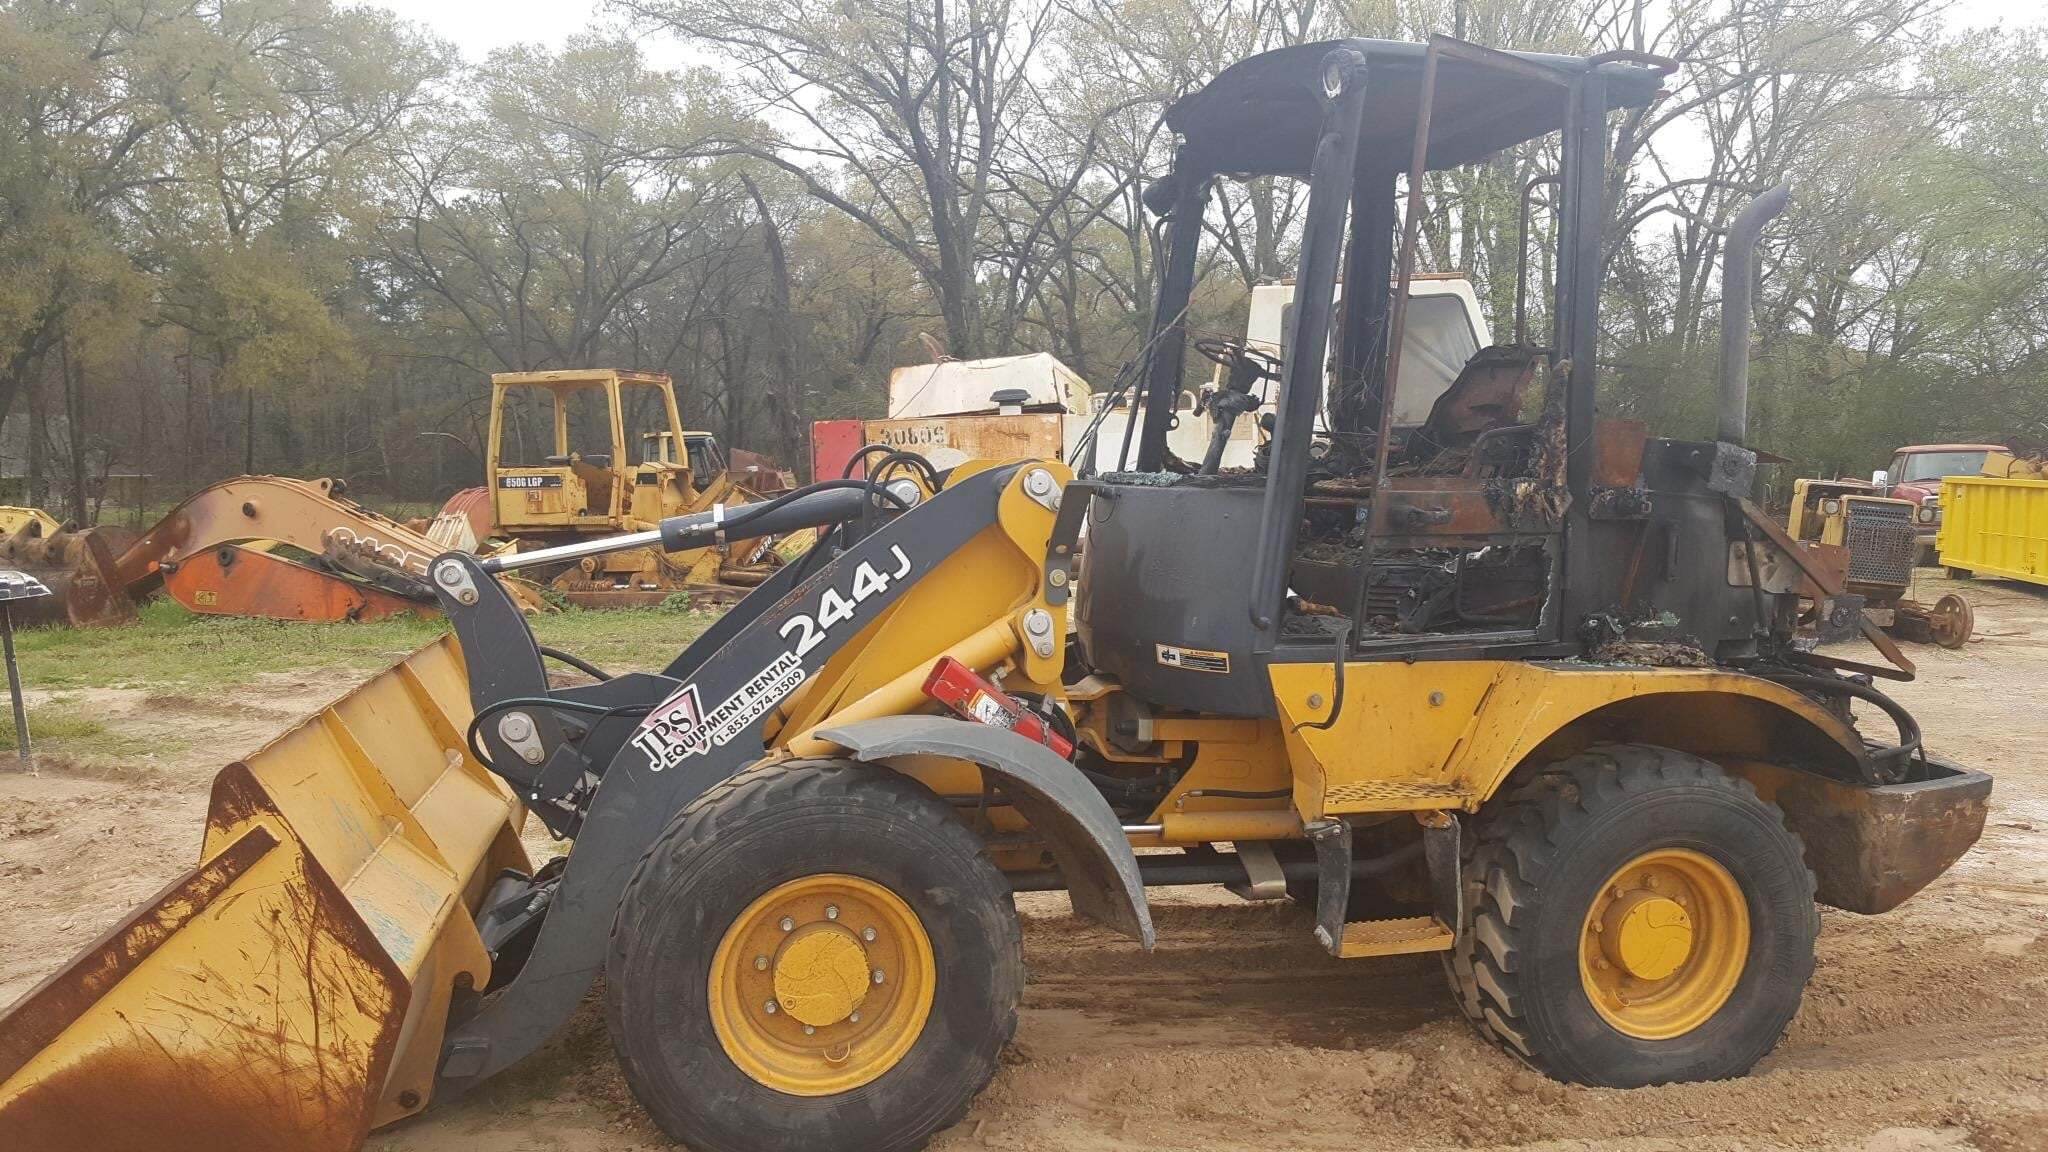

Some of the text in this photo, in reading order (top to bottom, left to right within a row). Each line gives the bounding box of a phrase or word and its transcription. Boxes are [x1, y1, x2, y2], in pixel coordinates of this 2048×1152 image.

[527, 477, 543, 487] LGP
[751, 535, 772, 564] DEERE
[779, 544, 911, 657] 244J
[636, 709, 693, 768] JPS
[664, 655, 798, 764] EQUIPMENT RENTAL
[716, 671, 801, 743] 1-855-674-3509
